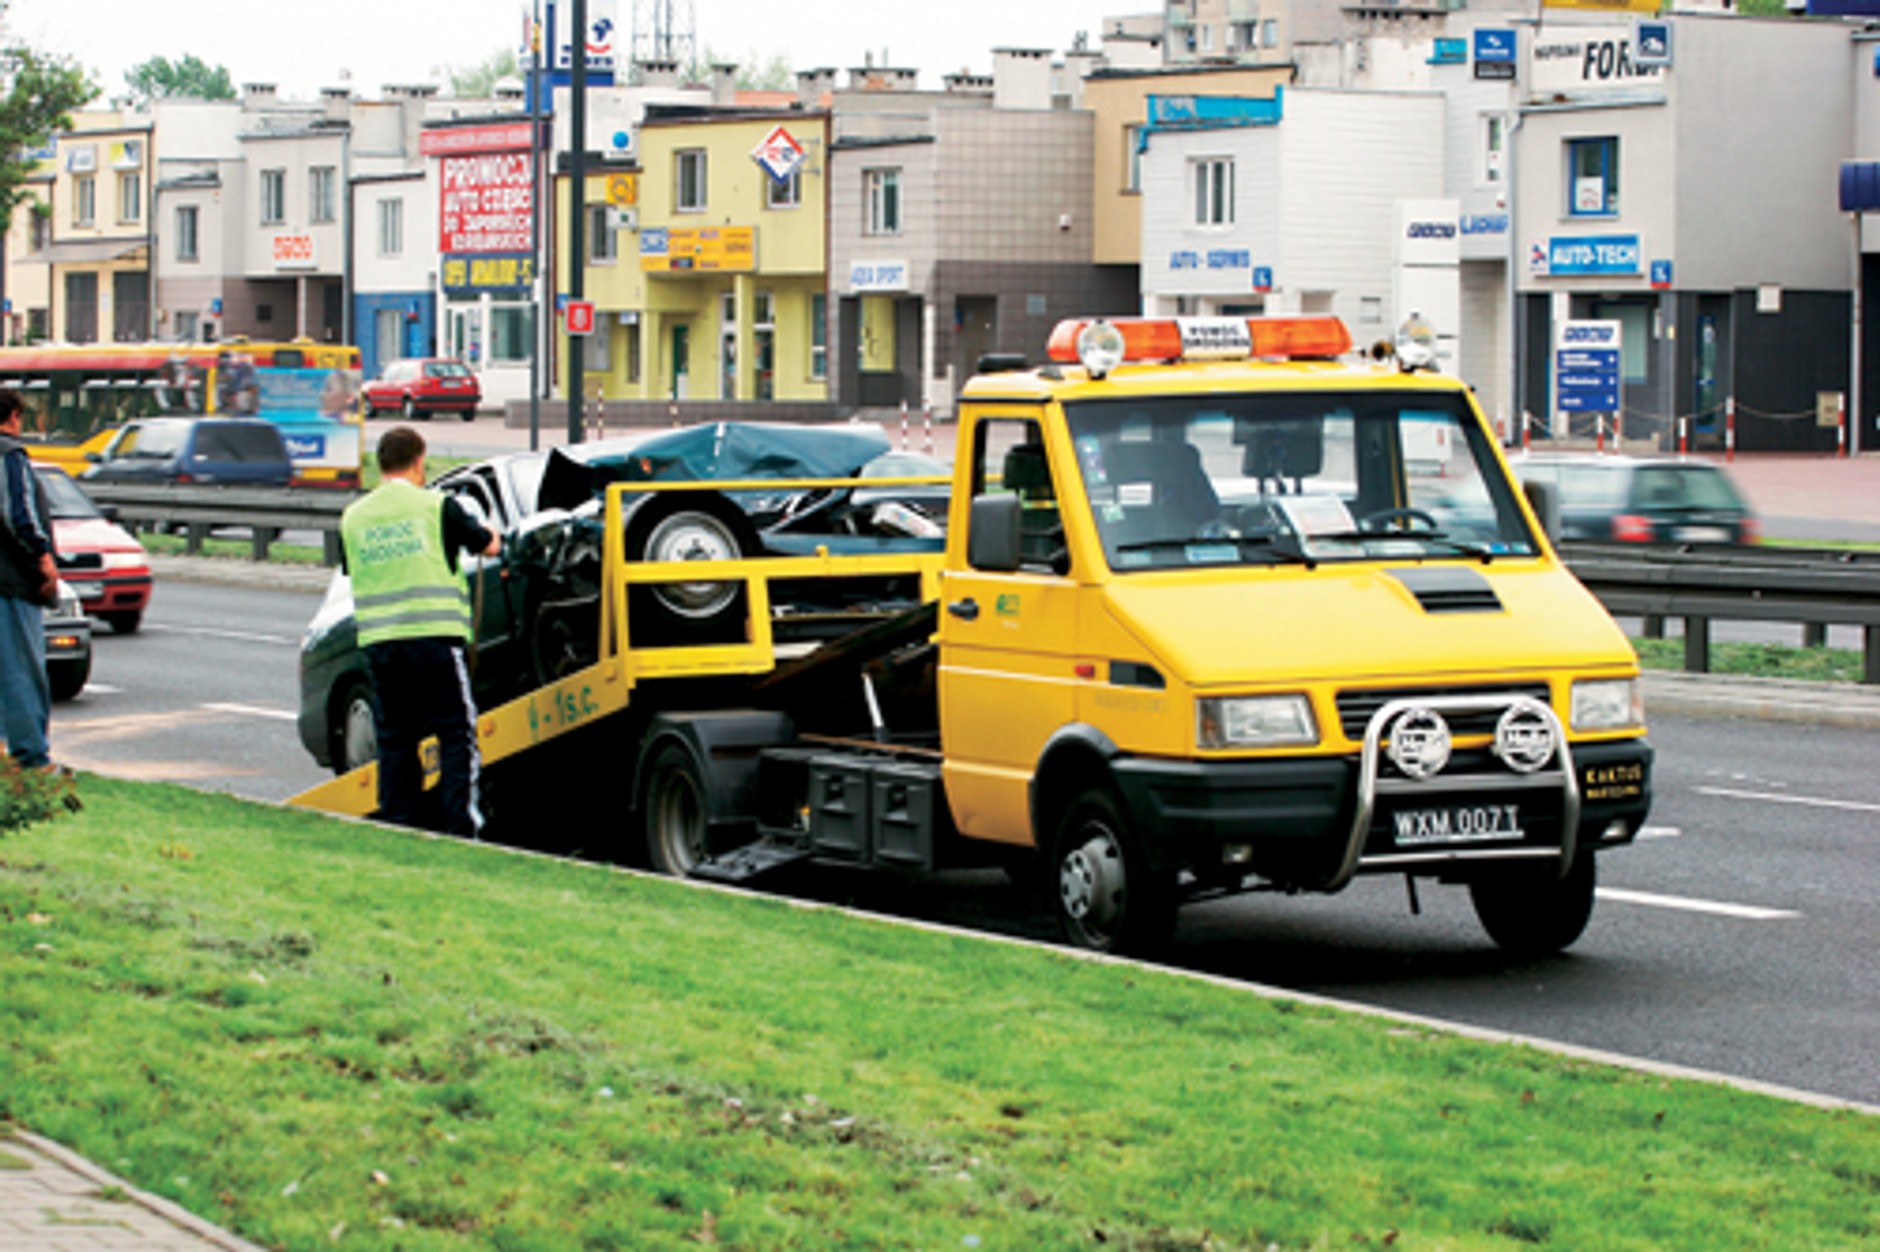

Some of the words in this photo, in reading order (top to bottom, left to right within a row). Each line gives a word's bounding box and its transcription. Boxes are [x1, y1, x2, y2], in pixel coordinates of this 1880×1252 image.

[1552, 243, 1638, 266] AUTO-TECH
[366, 520, 414, 542] POMOC
[1393, 809, 1450, 837] WXM
